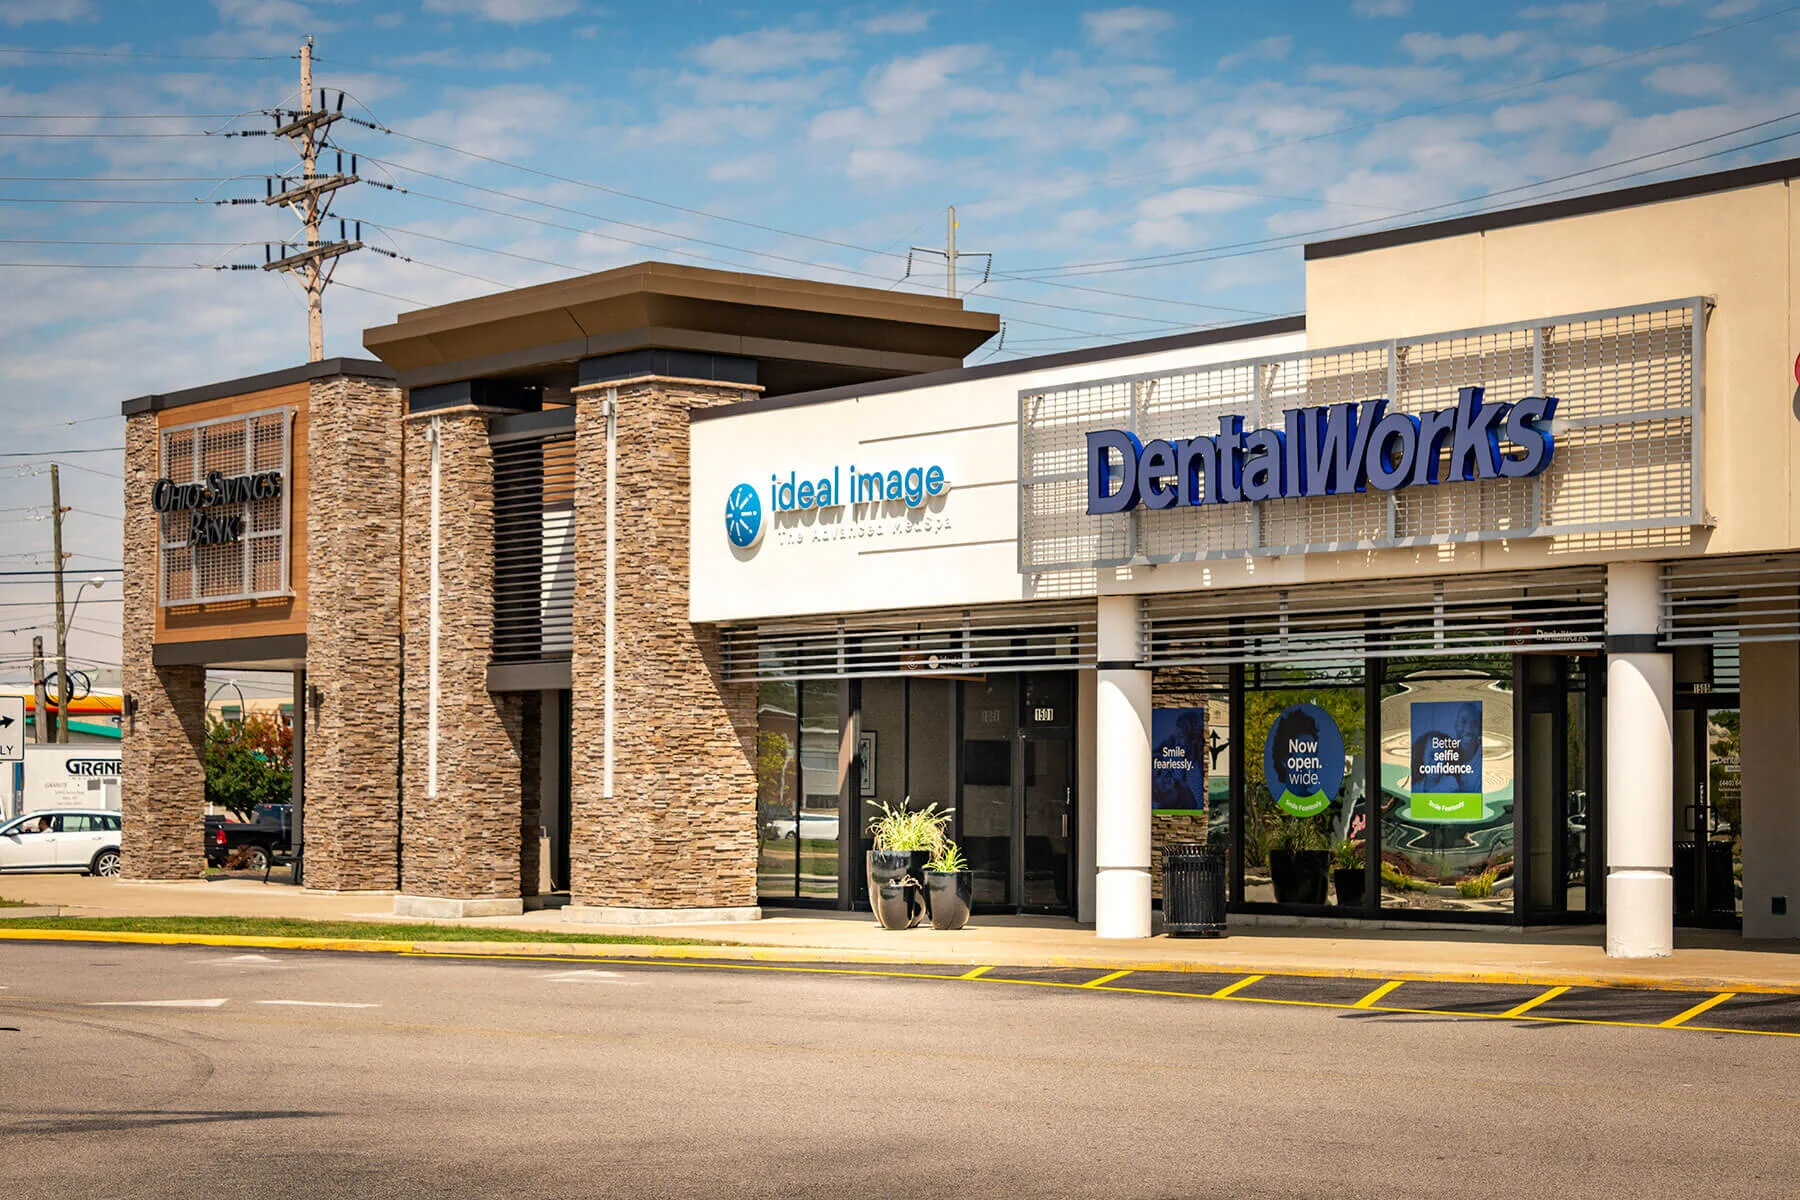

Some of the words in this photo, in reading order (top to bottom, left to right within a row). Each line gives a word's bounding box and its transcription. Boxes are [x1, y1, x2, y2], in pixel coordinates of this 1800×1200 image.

[1085, 386, 1559, 515] DentalWorks
[772, 466, 839, 512] ideal
[850, 465, 945, 508] image
[1288, 738, 1318, 753] Now
[1432, 737, 1461, 749] Better
[1162, 746, 1186, 757] Smile
[1433, 750, 1459, 761] selfie
[1153, 758, 1194, 771] fearlessly.
[1287, 757, 1322, 772] open.
[1419, 762, 1474, 775] confidence.
[1289, 769, 1321, 785] wide.
